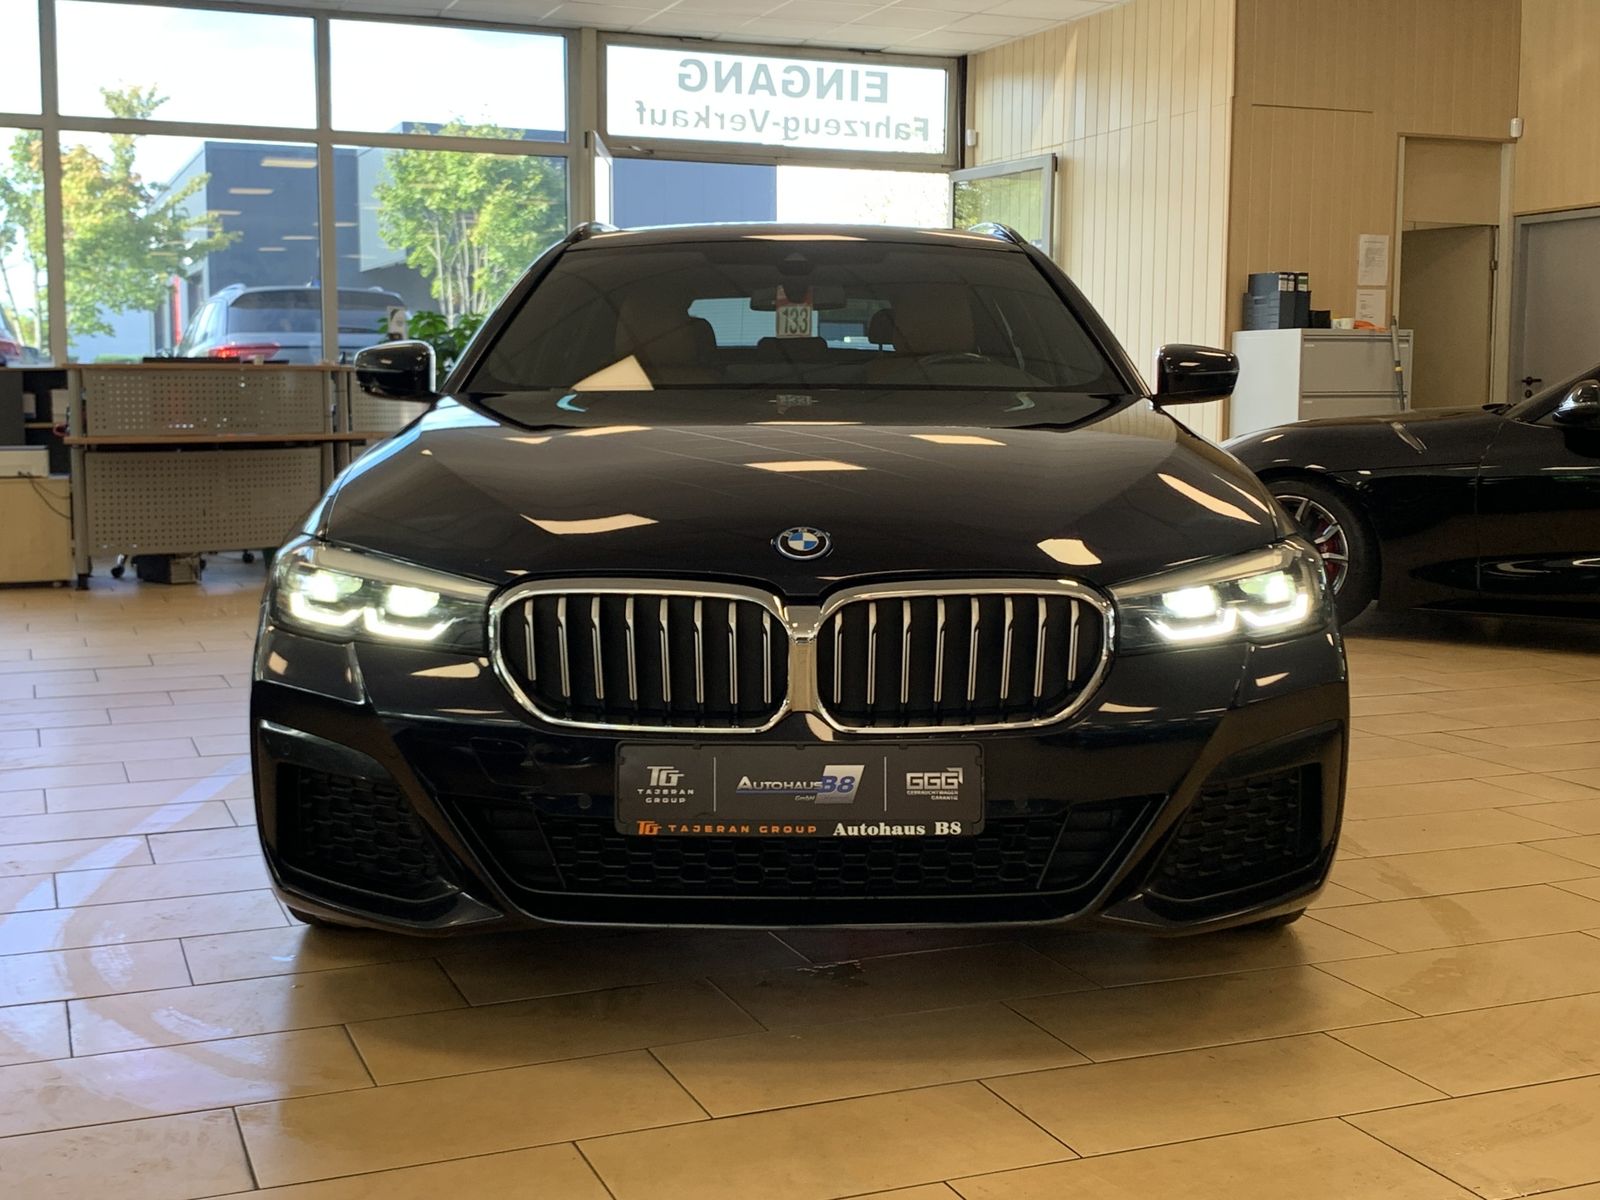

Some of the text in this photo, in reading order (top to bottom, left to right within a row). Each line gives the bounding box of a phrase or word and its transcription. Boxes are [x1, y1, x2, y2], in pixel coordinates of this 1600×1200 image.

[782, 308, 808, 334] 133
[906, 772, 958, 790] GGG
[668, 824, 750, 833] TAJERAN
[759, 825, 817, 833] GROUP
[833, 822, 961, 836] Autohaus B8
